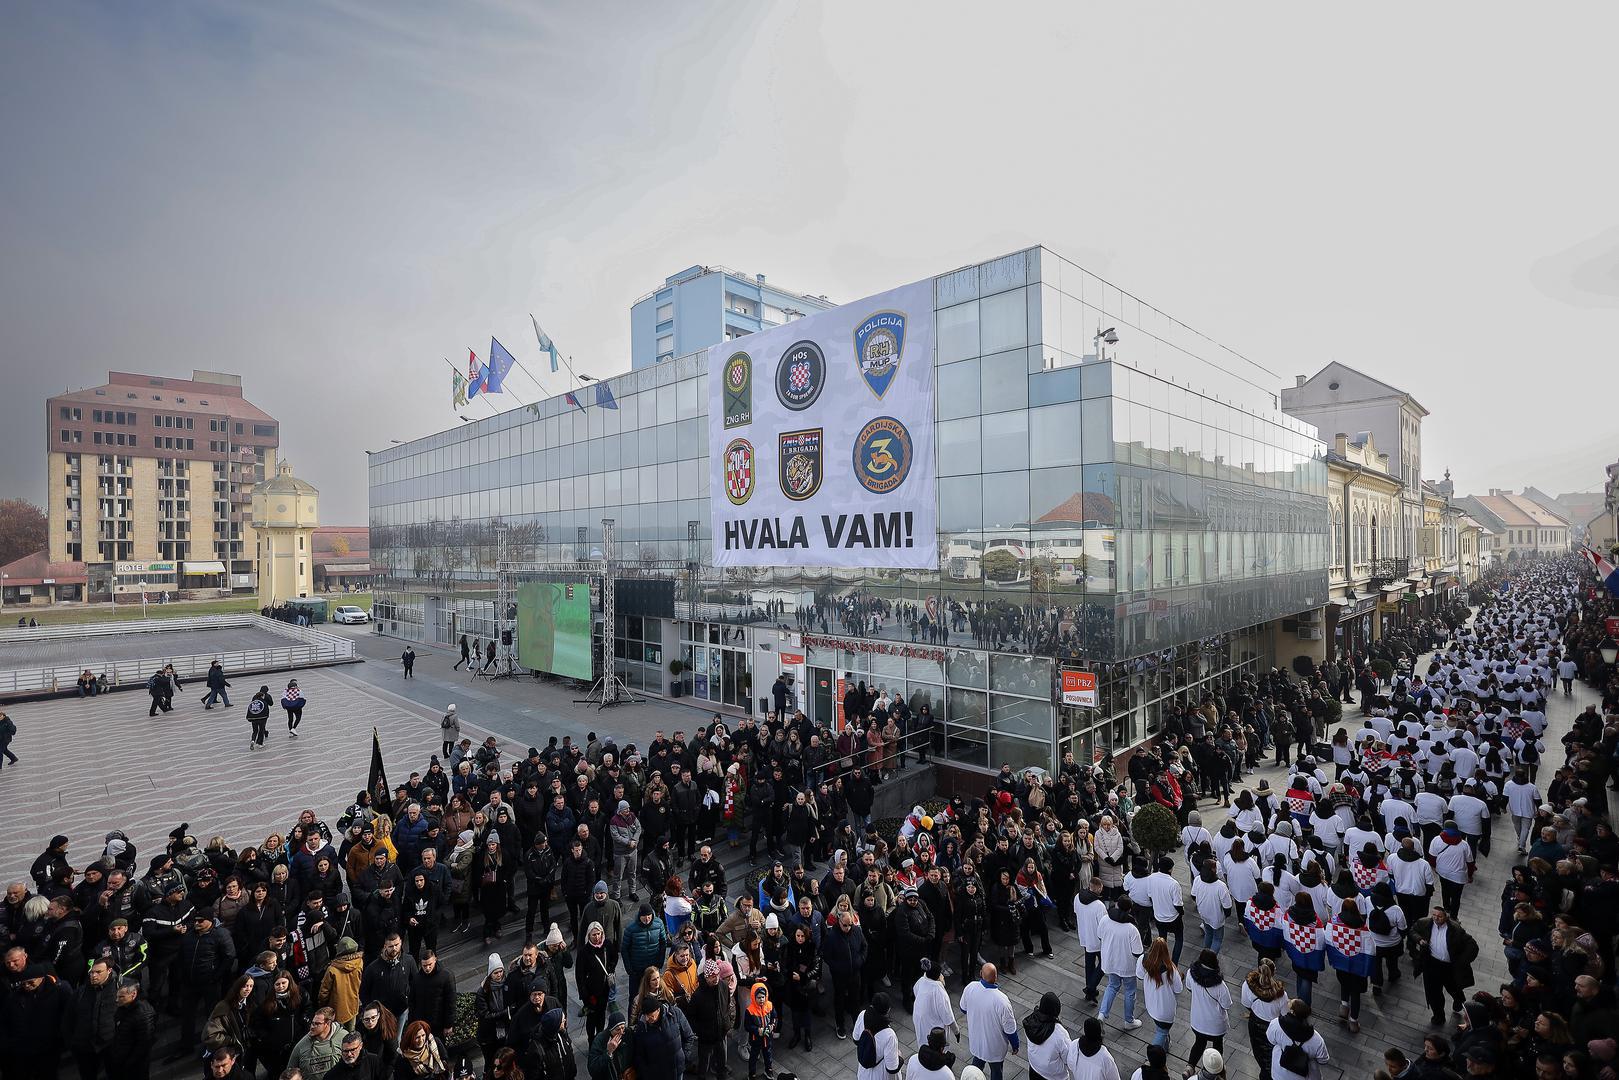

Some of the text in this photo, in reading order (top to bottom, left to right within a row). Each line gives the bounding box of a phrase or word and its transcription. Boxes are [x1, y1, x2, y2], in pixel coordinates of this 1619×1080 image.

[858, 317, 903, 339] POLICIJA
[870, 340, 890, 358] RH
[792, 351, 808, 362] HOS
[870, 357, 890, 368] MUP
[726, 412, 750, 425] ZNG RH
[861, 421, 903, 442] GARDIJSKA
[788, 445, 818, 454] BRIGADA
[867, 438, 893, 474] 3
[867, 477, 898, 490] BRIGADA
[724, 511, 914, 550] HVALA VAM!
[117, 564, 146, 572] HOTEL
[1077, 678, 1092, 688] PBZ
